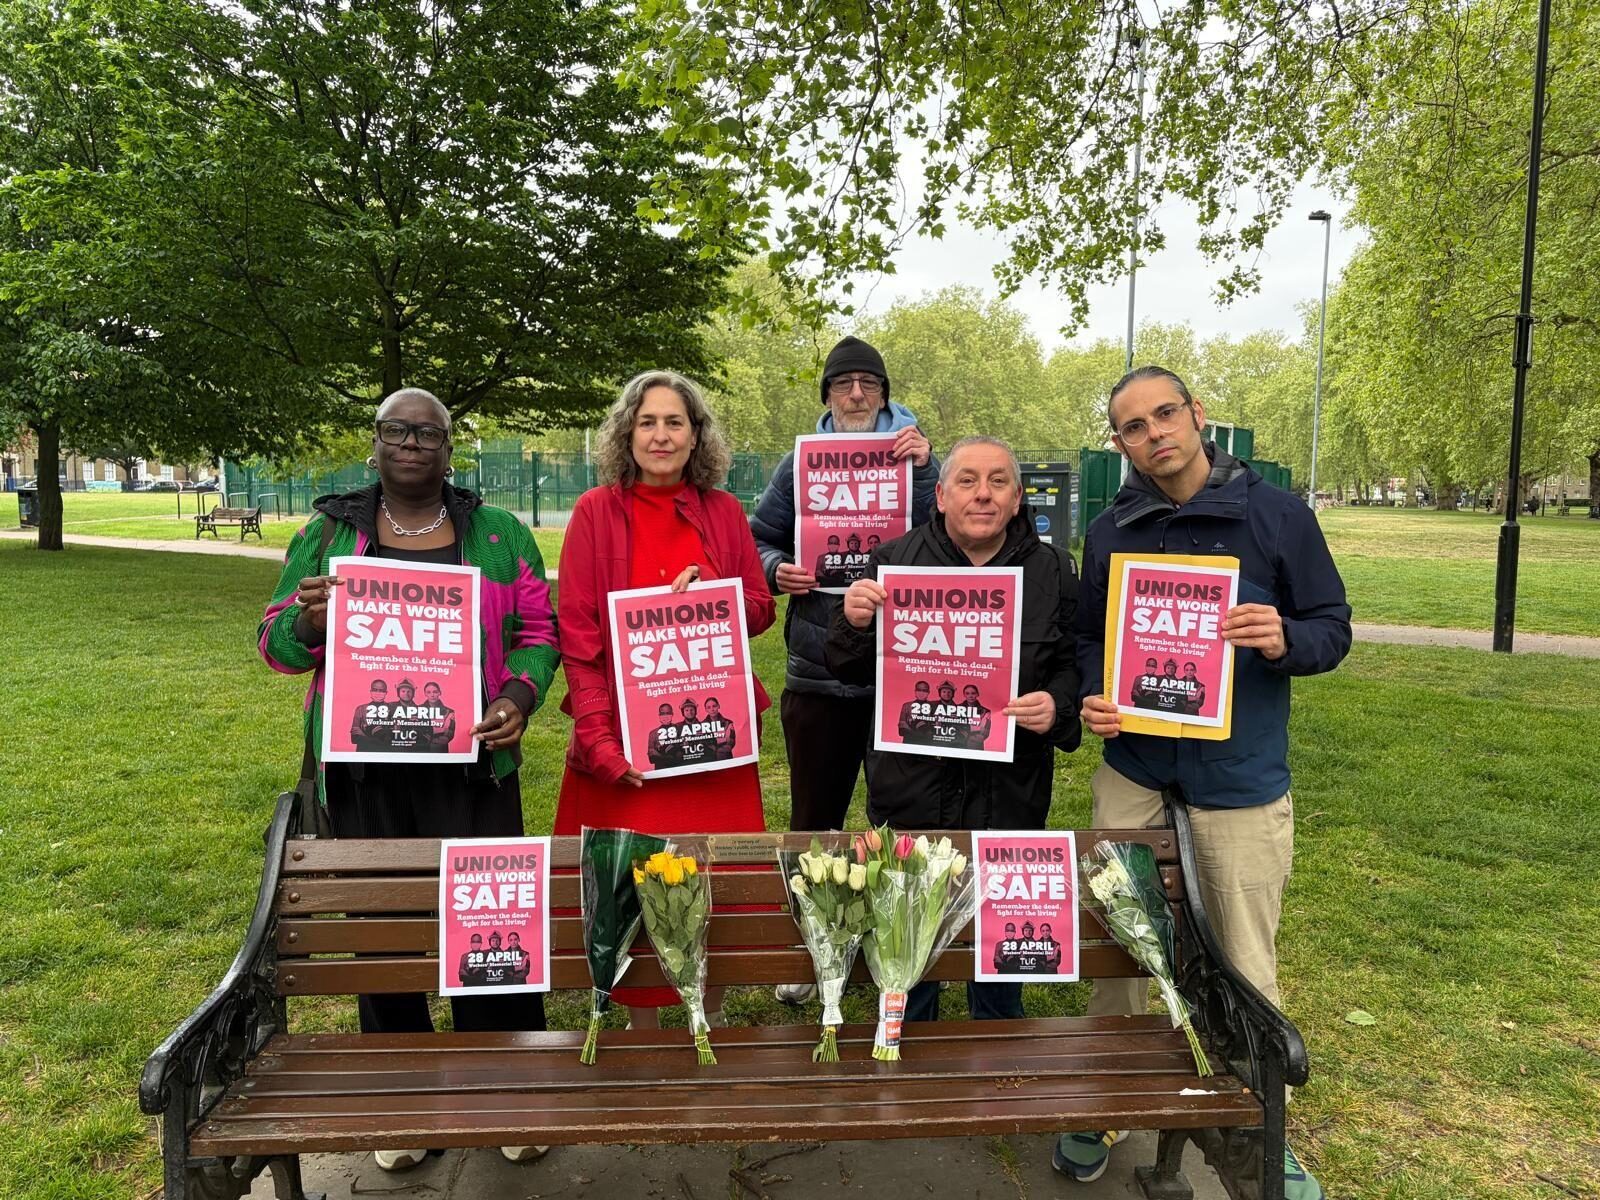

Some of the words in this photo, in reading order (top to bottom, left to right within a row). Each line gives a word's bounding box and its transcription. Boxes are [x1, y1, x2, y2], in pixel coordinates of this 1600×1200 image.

[808, 451, 898, 469] UNIONS
[808, 471, 849, 482] MAKE
[853, 469, 898, 481] WORK
[808, 482, 898, 511] SAFE
[825, 555, 841, 564] 28
[845, 555, 870, 564] APR
[347, 578, 463, 606] UNIONS
[1136, 579, 1223, 601] UNIONS
[893, 589, 1006, 609] UNIONS
[1134, 596, 1173, 608] MAKE
[1177, 600, 1219, 613] WORK
[347, 600, 401, 615] MAKE
[406, 604, 462, 620] WORK
[626, 600, 730, 629] UNIONS
[894, 610, 944, 623] MAKE
[949, 611, 1004, 624] WORK
[1131, 608, 1218, 640] SAFE
[344, 614, 463, 653] SAFE
[628, 628, 676, 645] MAKE
[680, 621, 732, 638] WORK
[892, 623, 1002, 658] SAFE
[1135, 636, 1175, 646] Remember
[351, 653, 408, 663] Remember
[430, 658, 456, 667] dead,
[630, 635, 735, 677] SAFE
[1183, 649, 1205, 657] living
[360, 662, 382, 671] fight
[386, 663, 399, 671] for
[403, 664, 418, 672] the
[421, 665, 449, 675] living
[898, 656, 950, 666] Remember
[953, 660, 967, 668] the
[970, 662, 996, 670] dead,
[906, 664, 925, 673] fight
[944, 667, 958, 675] the
[960, 668, 988, 678] living
[638, 678, 688, 689] Remember
[647, 689, 666, 697] fight
[700, 681, 725, 689] living
[1142, 676, 1157, 686] 28
[1160, 679, 1197, 691] APRIL
[1159, 695, 1176, 703] TUC
[366, 705, 388, 718] 28
[393, 706, 444, 719] APRIL
[911, 703, 930, 714] 28
[935, 704, 980, 717] APRIL
[938, 716, 967, 724] Memorial
[392, 730, 417, 740] TUC
[658, 727, 677, 739] 28
[681, 721, 724, 736] APRIL
[934, 726, 956, 736] TUC
[683, 744, 704, 754] TUC
[986, 848, 1064, 862] UNIONS
[455, 854, 536, 872] UNIONS
[987, 864, 1023, 873] MAKE
[1026, 864, 1064, 873] WORK
[454, 873, 492, 884] MAKE
[495, 871, 536, 882] WORK
[987, 875, 1065, 900] SAFE
[452, 884, 535, 911] SAFE
[1003, 942, 1017, 950] 28
[1020, 942, 1053, 950] APRIL
[468, 953, 483, 963] 28
[486, 951, 522, 962] APRIL
[487, 969, 504, 977] TUC
